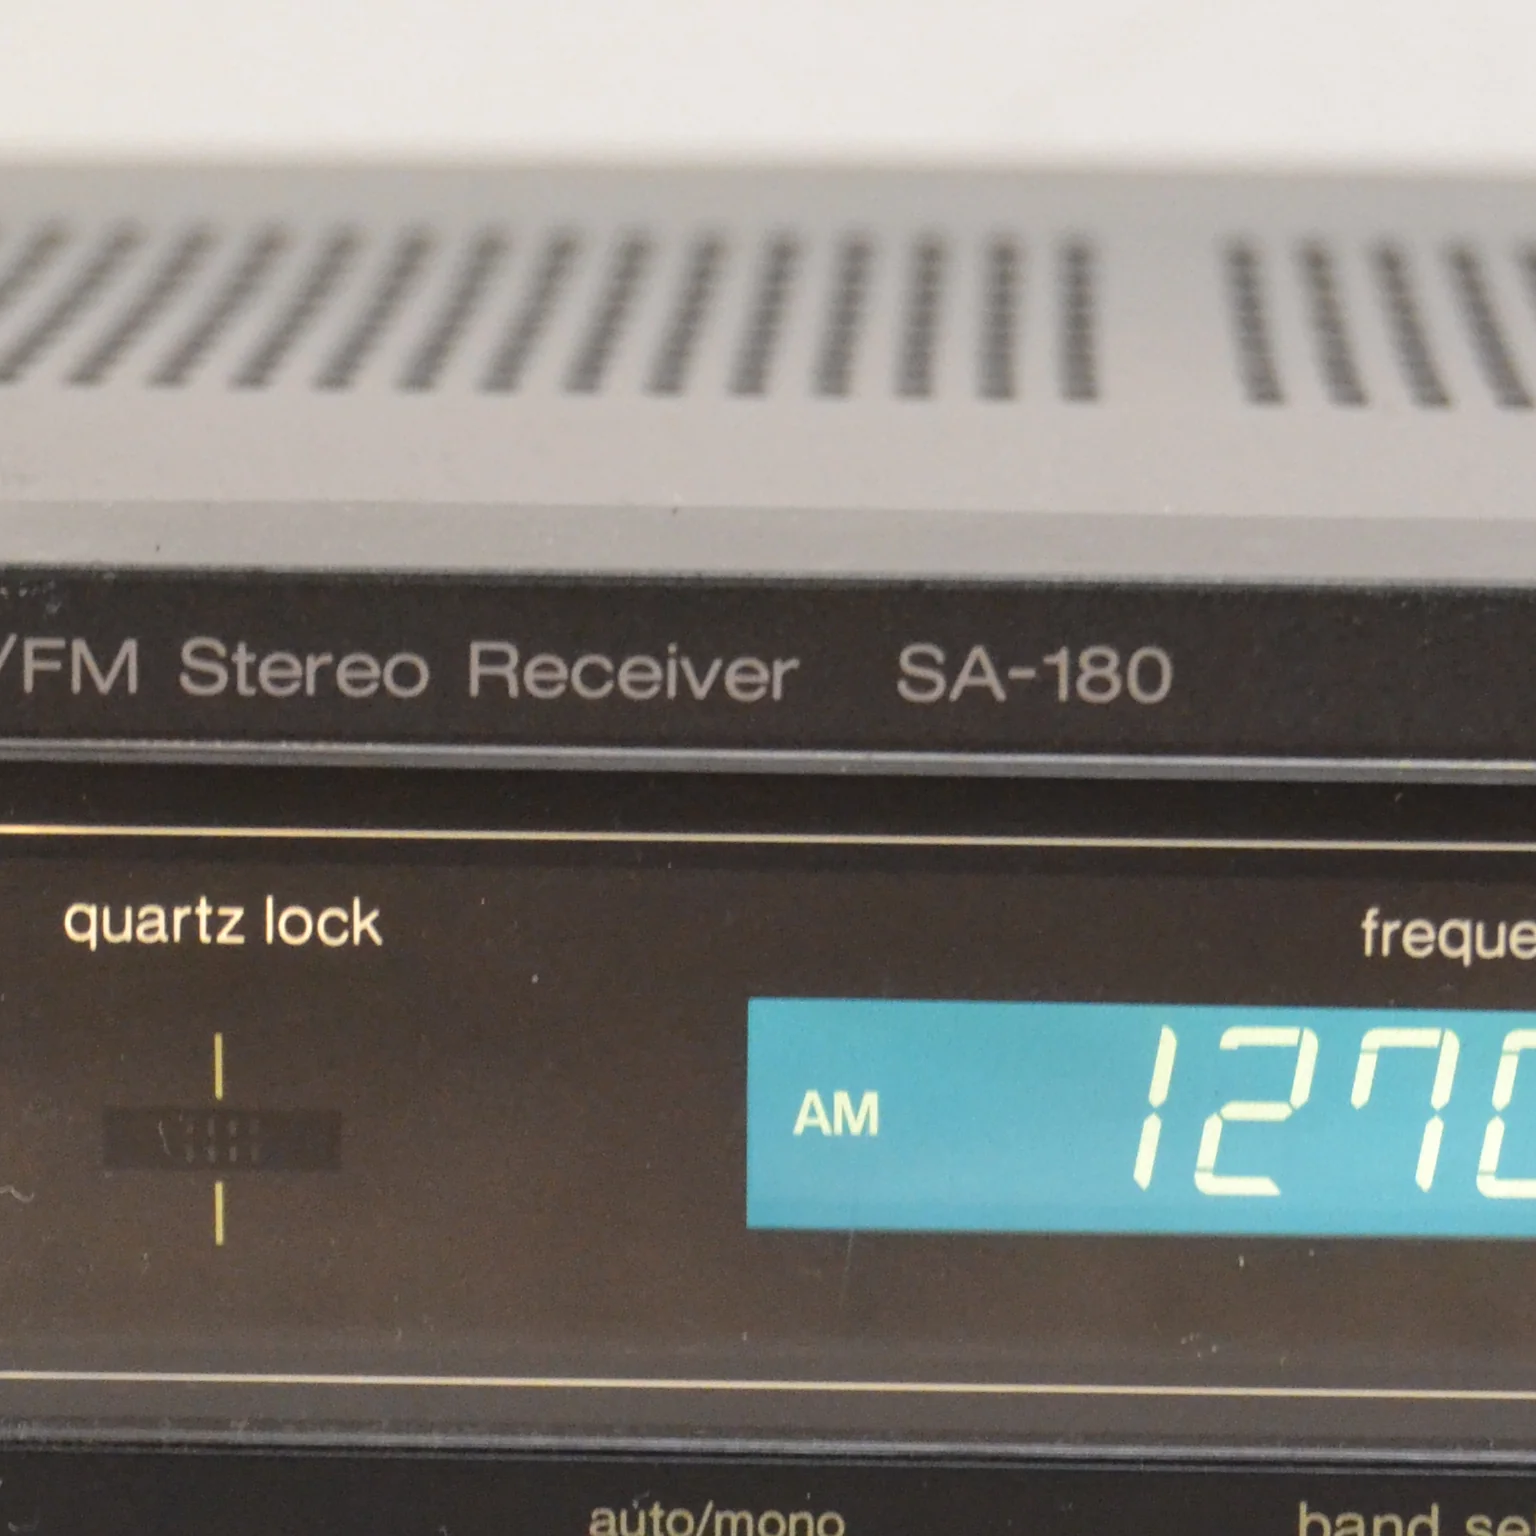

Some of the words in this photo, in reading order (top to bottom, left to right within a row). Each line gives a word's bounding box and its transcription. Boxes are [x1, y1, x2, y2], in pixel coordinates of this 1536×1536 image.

[179, 636, 430, 698] Stereo
[468, 640, 799, 702] Receiver
[896, 643, 1174, 705] SA-180
[63, 896, 245, 951] quartz
[264, 896, 384, 947] lock
[793, 1091, 880, 1137] AM
